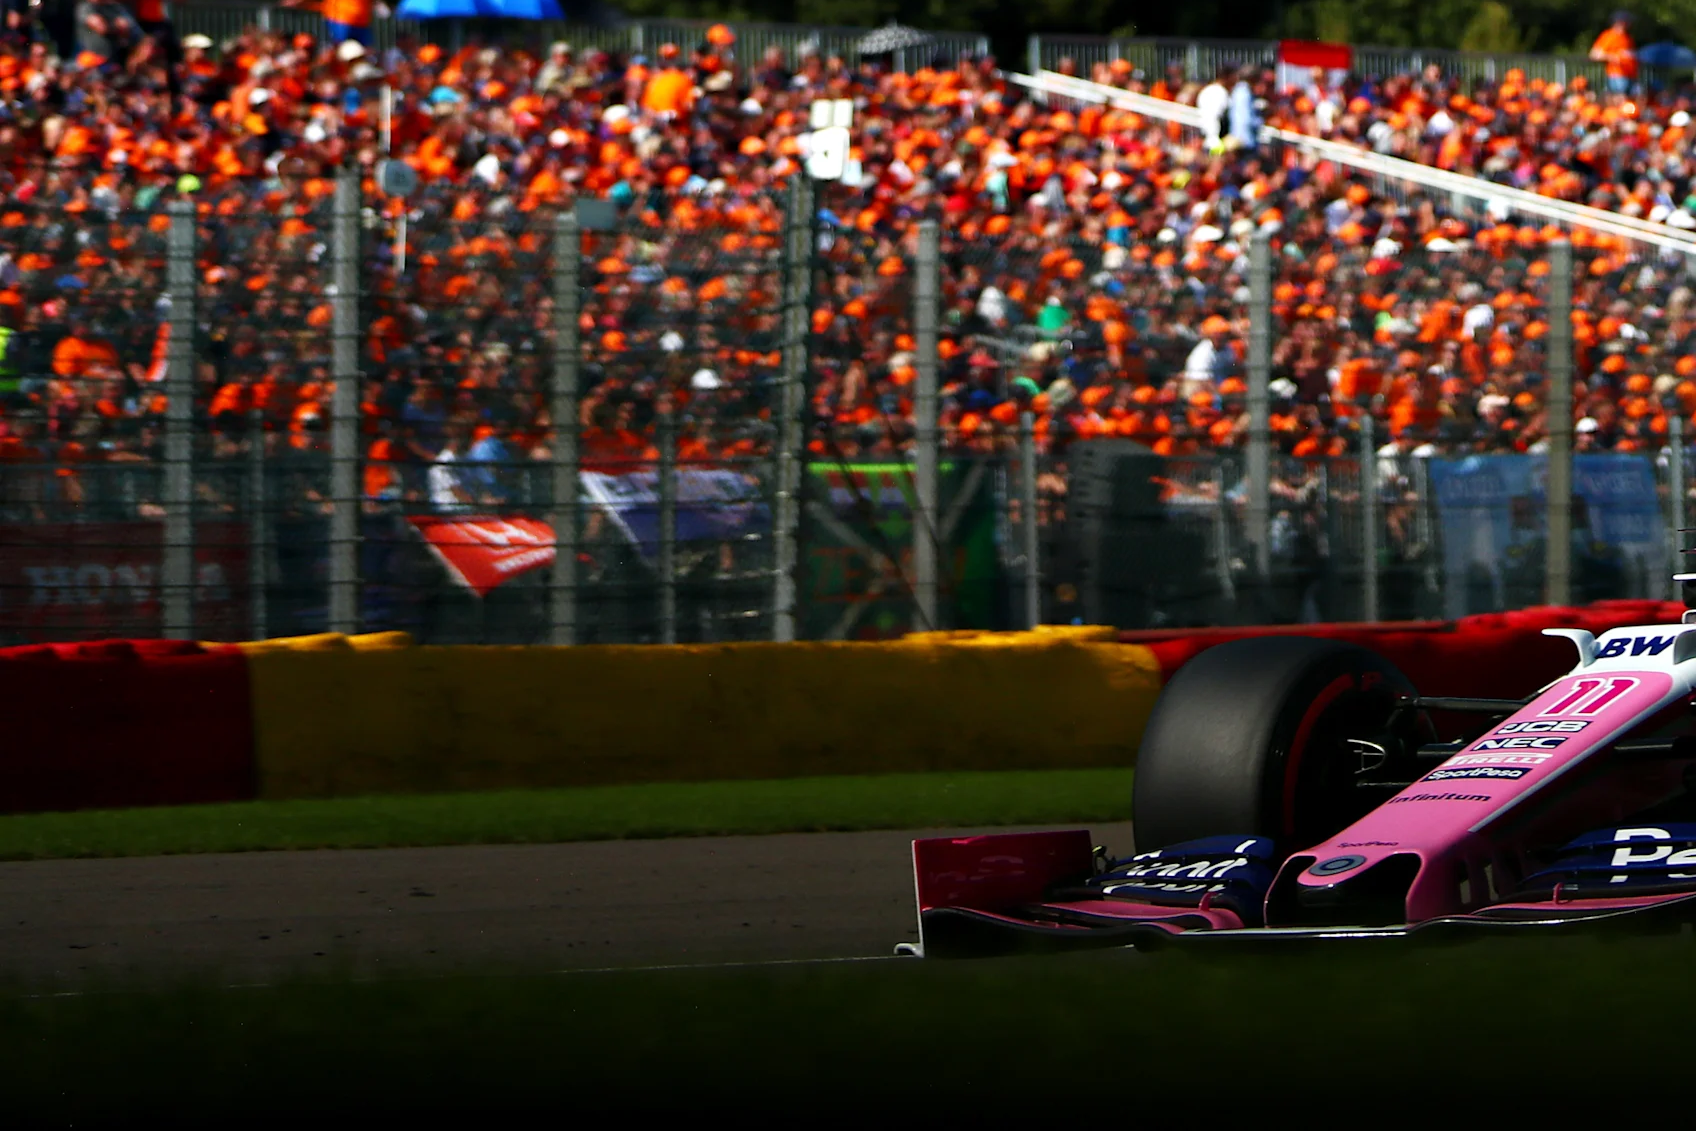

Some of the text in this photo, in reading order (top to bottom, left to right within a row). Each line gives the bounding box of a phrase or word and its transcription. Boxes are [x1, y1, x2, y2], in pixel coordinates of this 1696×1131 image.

[22, 563, 231, 603] HONA
[1595, 636, 1676, 659] BW
[1536, 677, 1641, 718] 11
[1496, 721, 1588, 734] JCB
[1472, 737, 1567, 750] NEC
[1444, 752, 1553, 767] PIRELLI
[1427, 767, 1523, 781] SportPesa
[1387, 792, 1492, 805] infinitum
